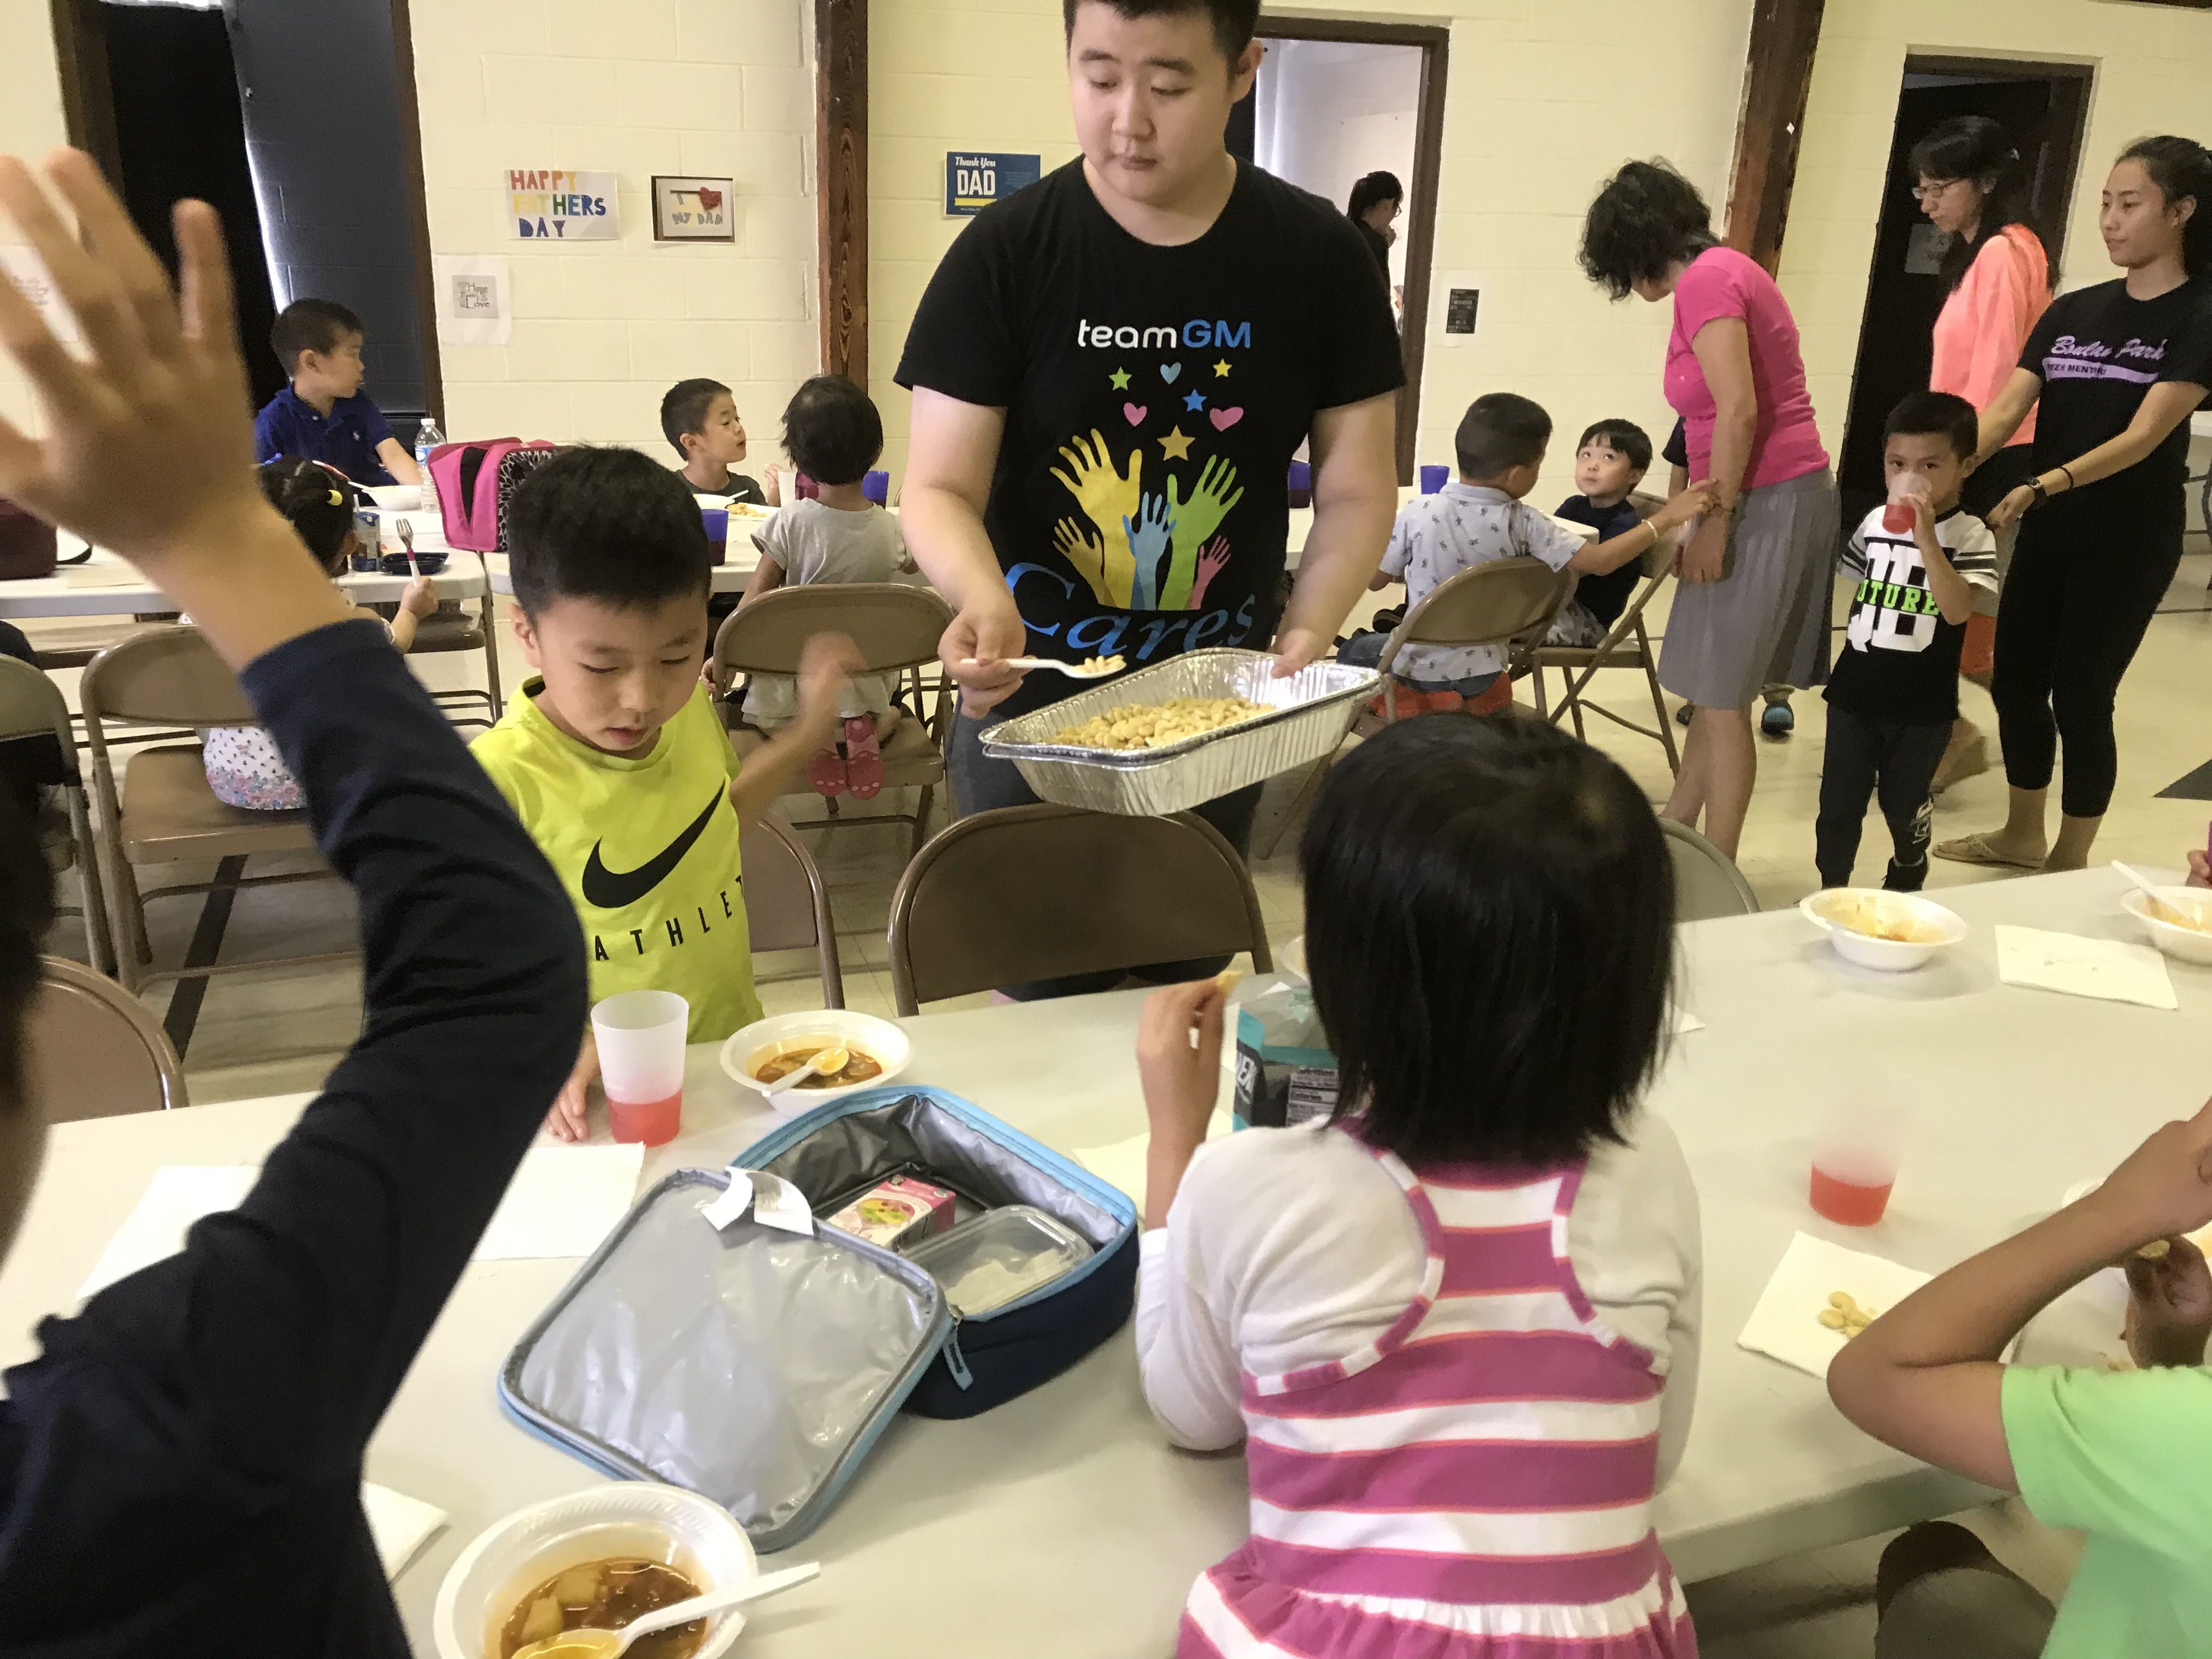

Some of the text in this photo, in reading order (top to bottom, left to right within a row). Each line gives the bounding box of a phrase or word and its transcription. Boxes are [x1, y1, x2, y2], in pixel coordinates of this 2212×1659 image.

[955, 156, 996, 168] Thank You
[510, 170, 576, 191] HAPPY
[957, 170, 996, 195] DAD
[513, 193, 606, 216] FATHERS
[518, 217, 566, 238] DAY
[672, 212, 723, 225] MY DAD
[1077, 319, 1251, 348] teamGM
[1005, 562, 1255, 661] Cares
